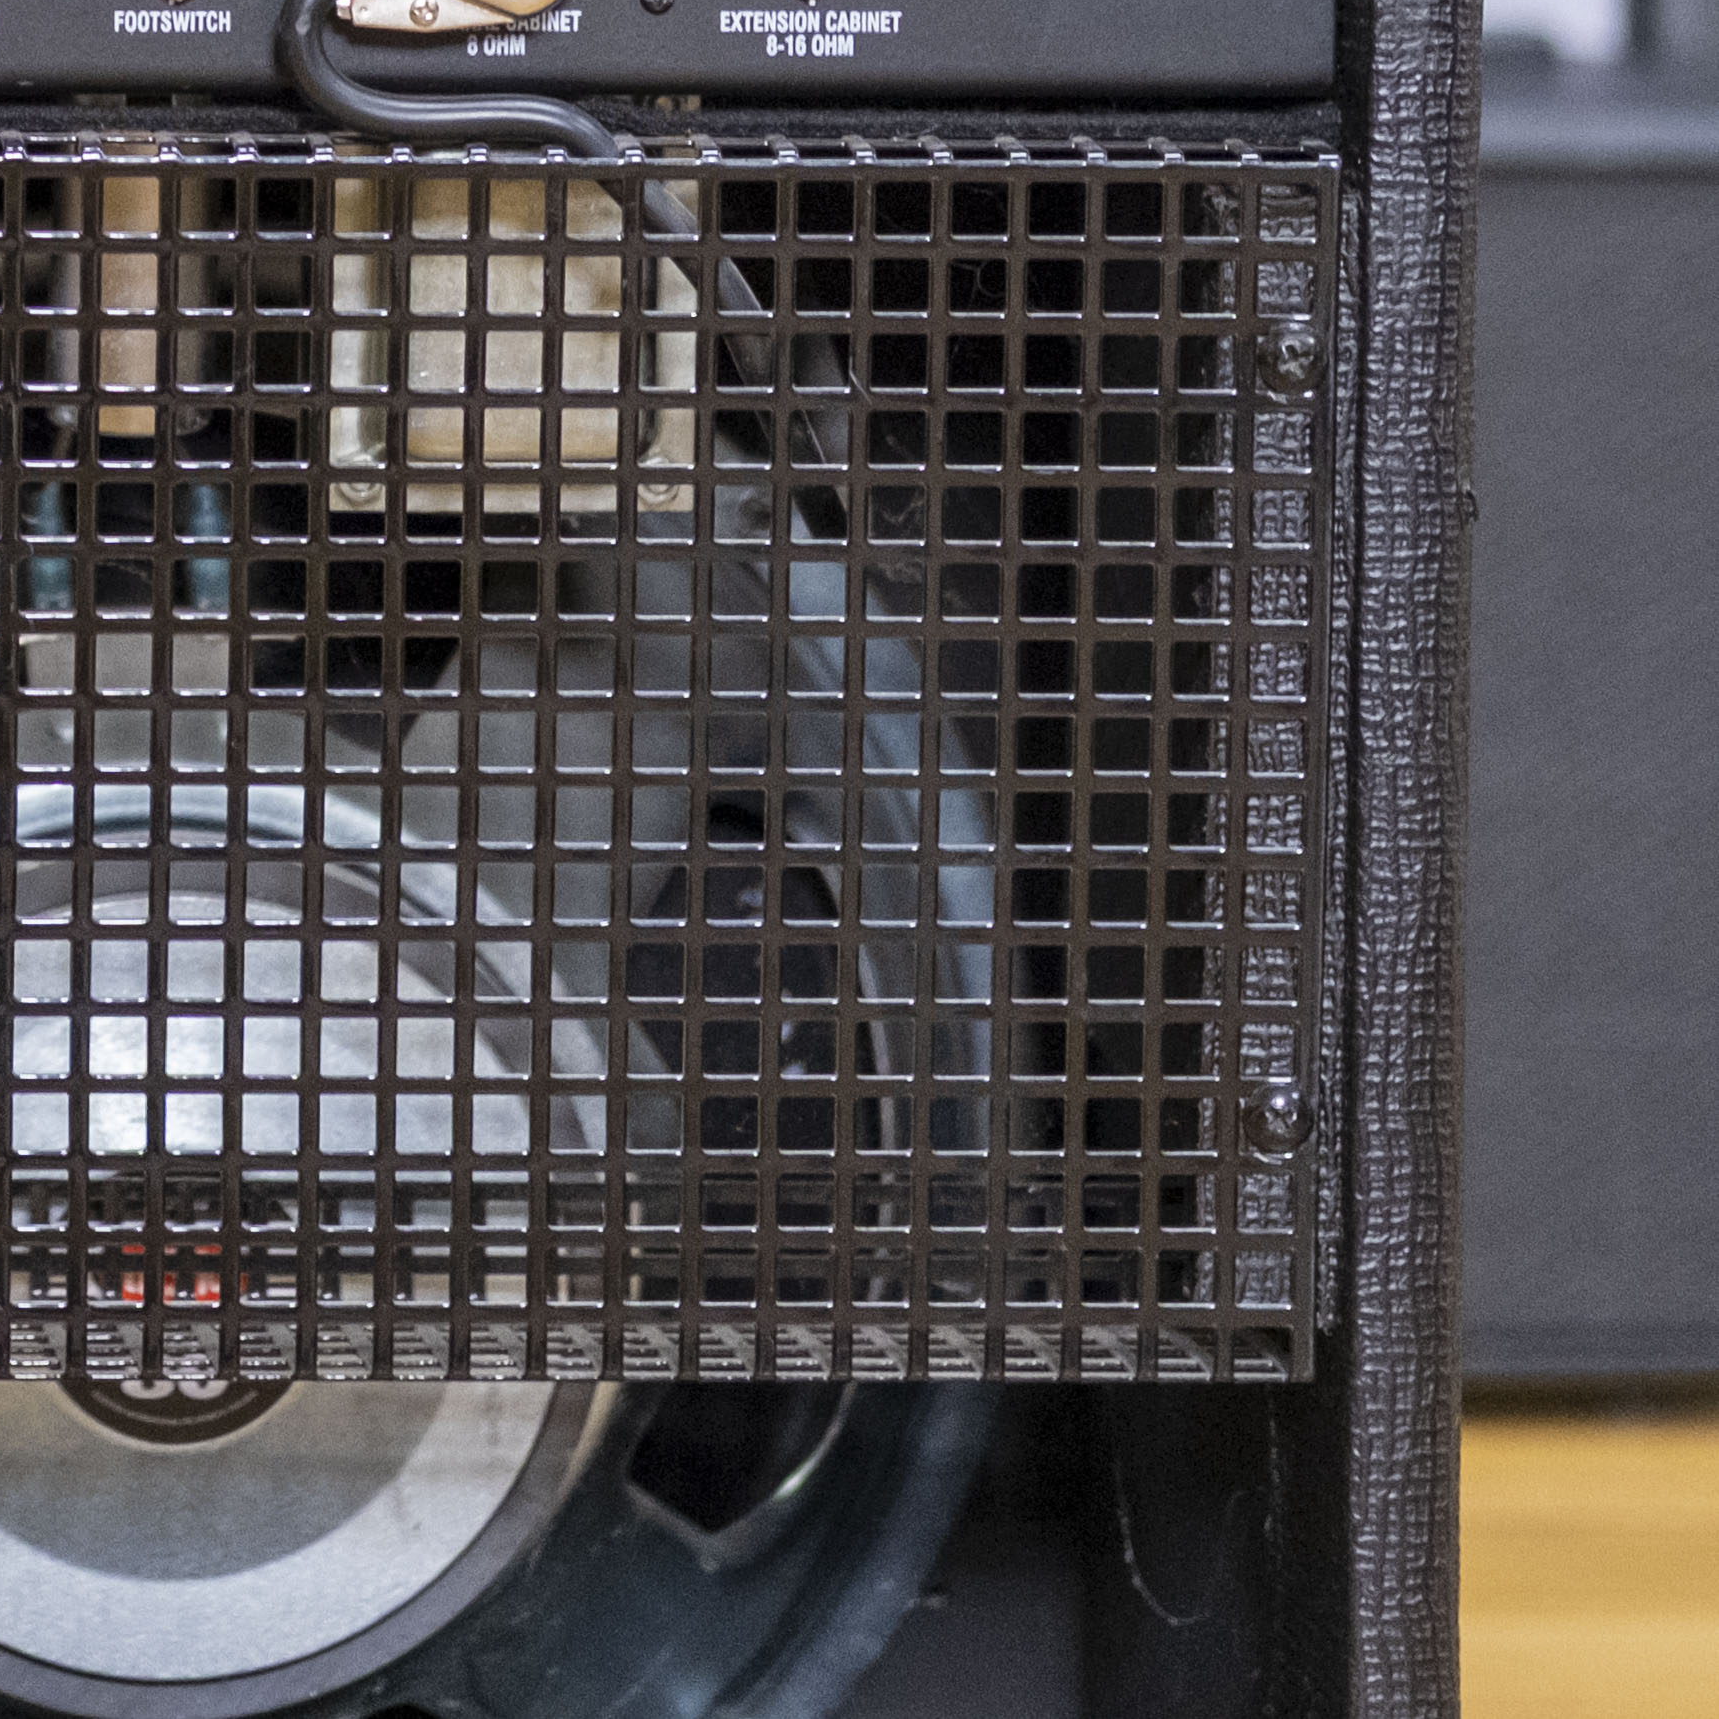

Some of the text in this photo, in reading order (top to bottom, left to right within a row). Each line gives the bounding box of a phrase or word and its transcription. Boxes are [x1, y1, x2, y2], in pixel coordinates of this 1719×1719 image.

[114, 11, 231, 34] FOOTSWITCH
[719, 10, 902, 33] EXTENSION CABINET
[467, 35, 526, 57] 8 OHM
[766, 34, 854, 57] 8-16 OHM
